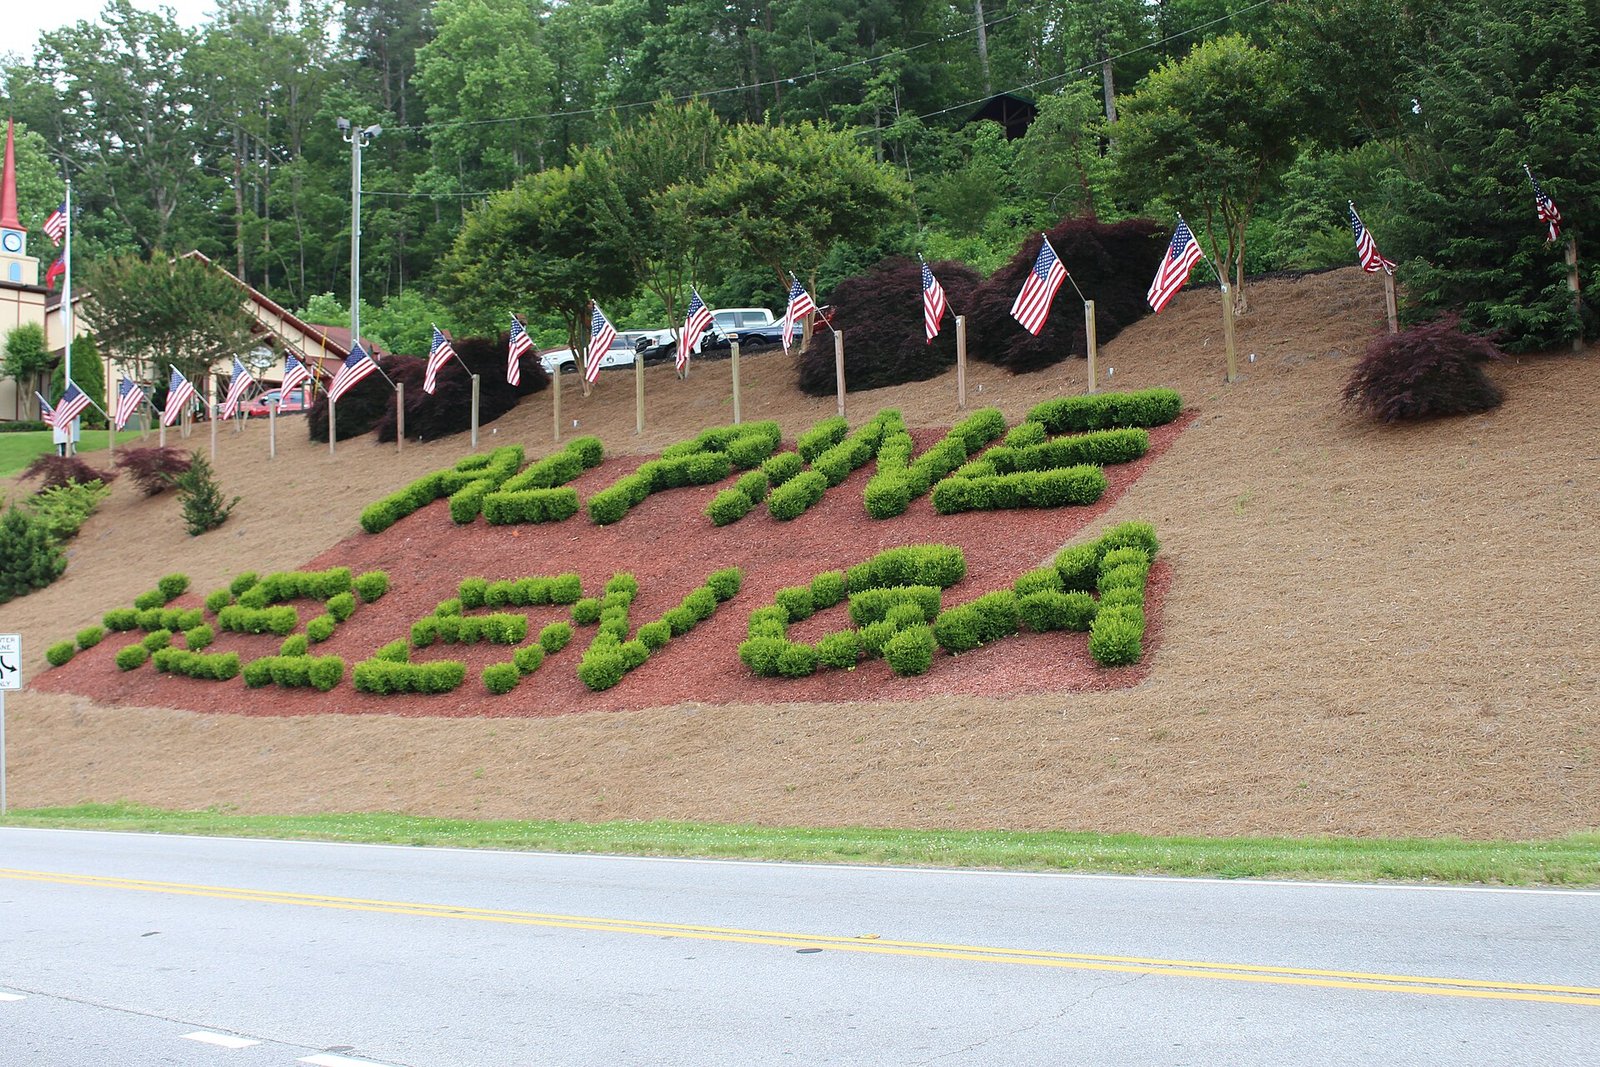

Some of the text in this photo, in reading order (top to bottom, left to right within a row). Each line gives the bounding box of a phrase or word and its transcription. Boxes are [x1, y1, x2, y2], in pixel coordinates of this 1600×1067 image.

[361, 388, 1181, 533] ALPINE
[48, 521, 1158, 694] HELEN GA
